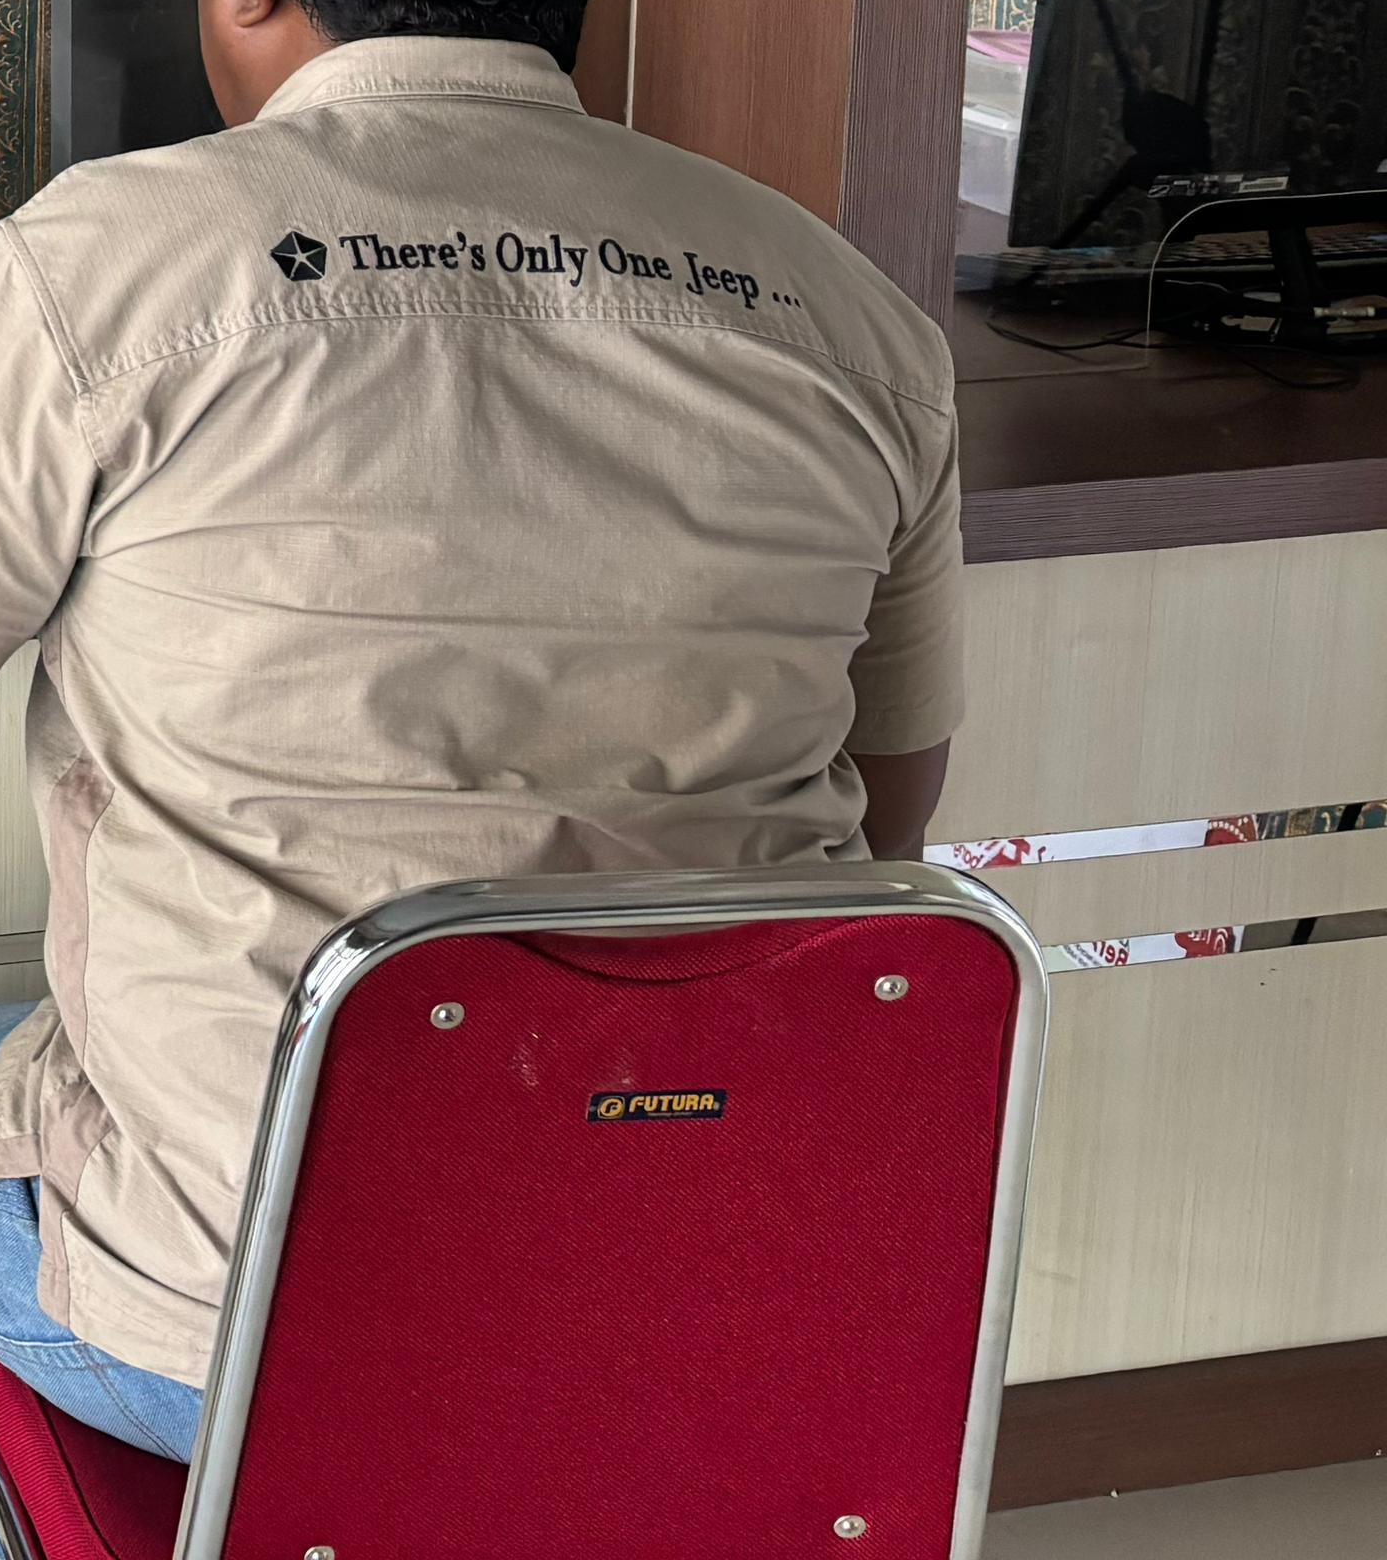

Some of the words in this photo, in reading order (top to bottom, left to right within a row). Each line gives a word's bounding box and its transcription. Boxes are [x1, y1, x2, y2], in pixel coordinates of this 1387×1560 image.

[339, 231, 486, 272] There's
[495, 232, 589, 287] Only
[598, 238, 673, 282] One
[685, 250, 760, 310] Jeep
[629, 1094, 715, 1112] FUTURA
